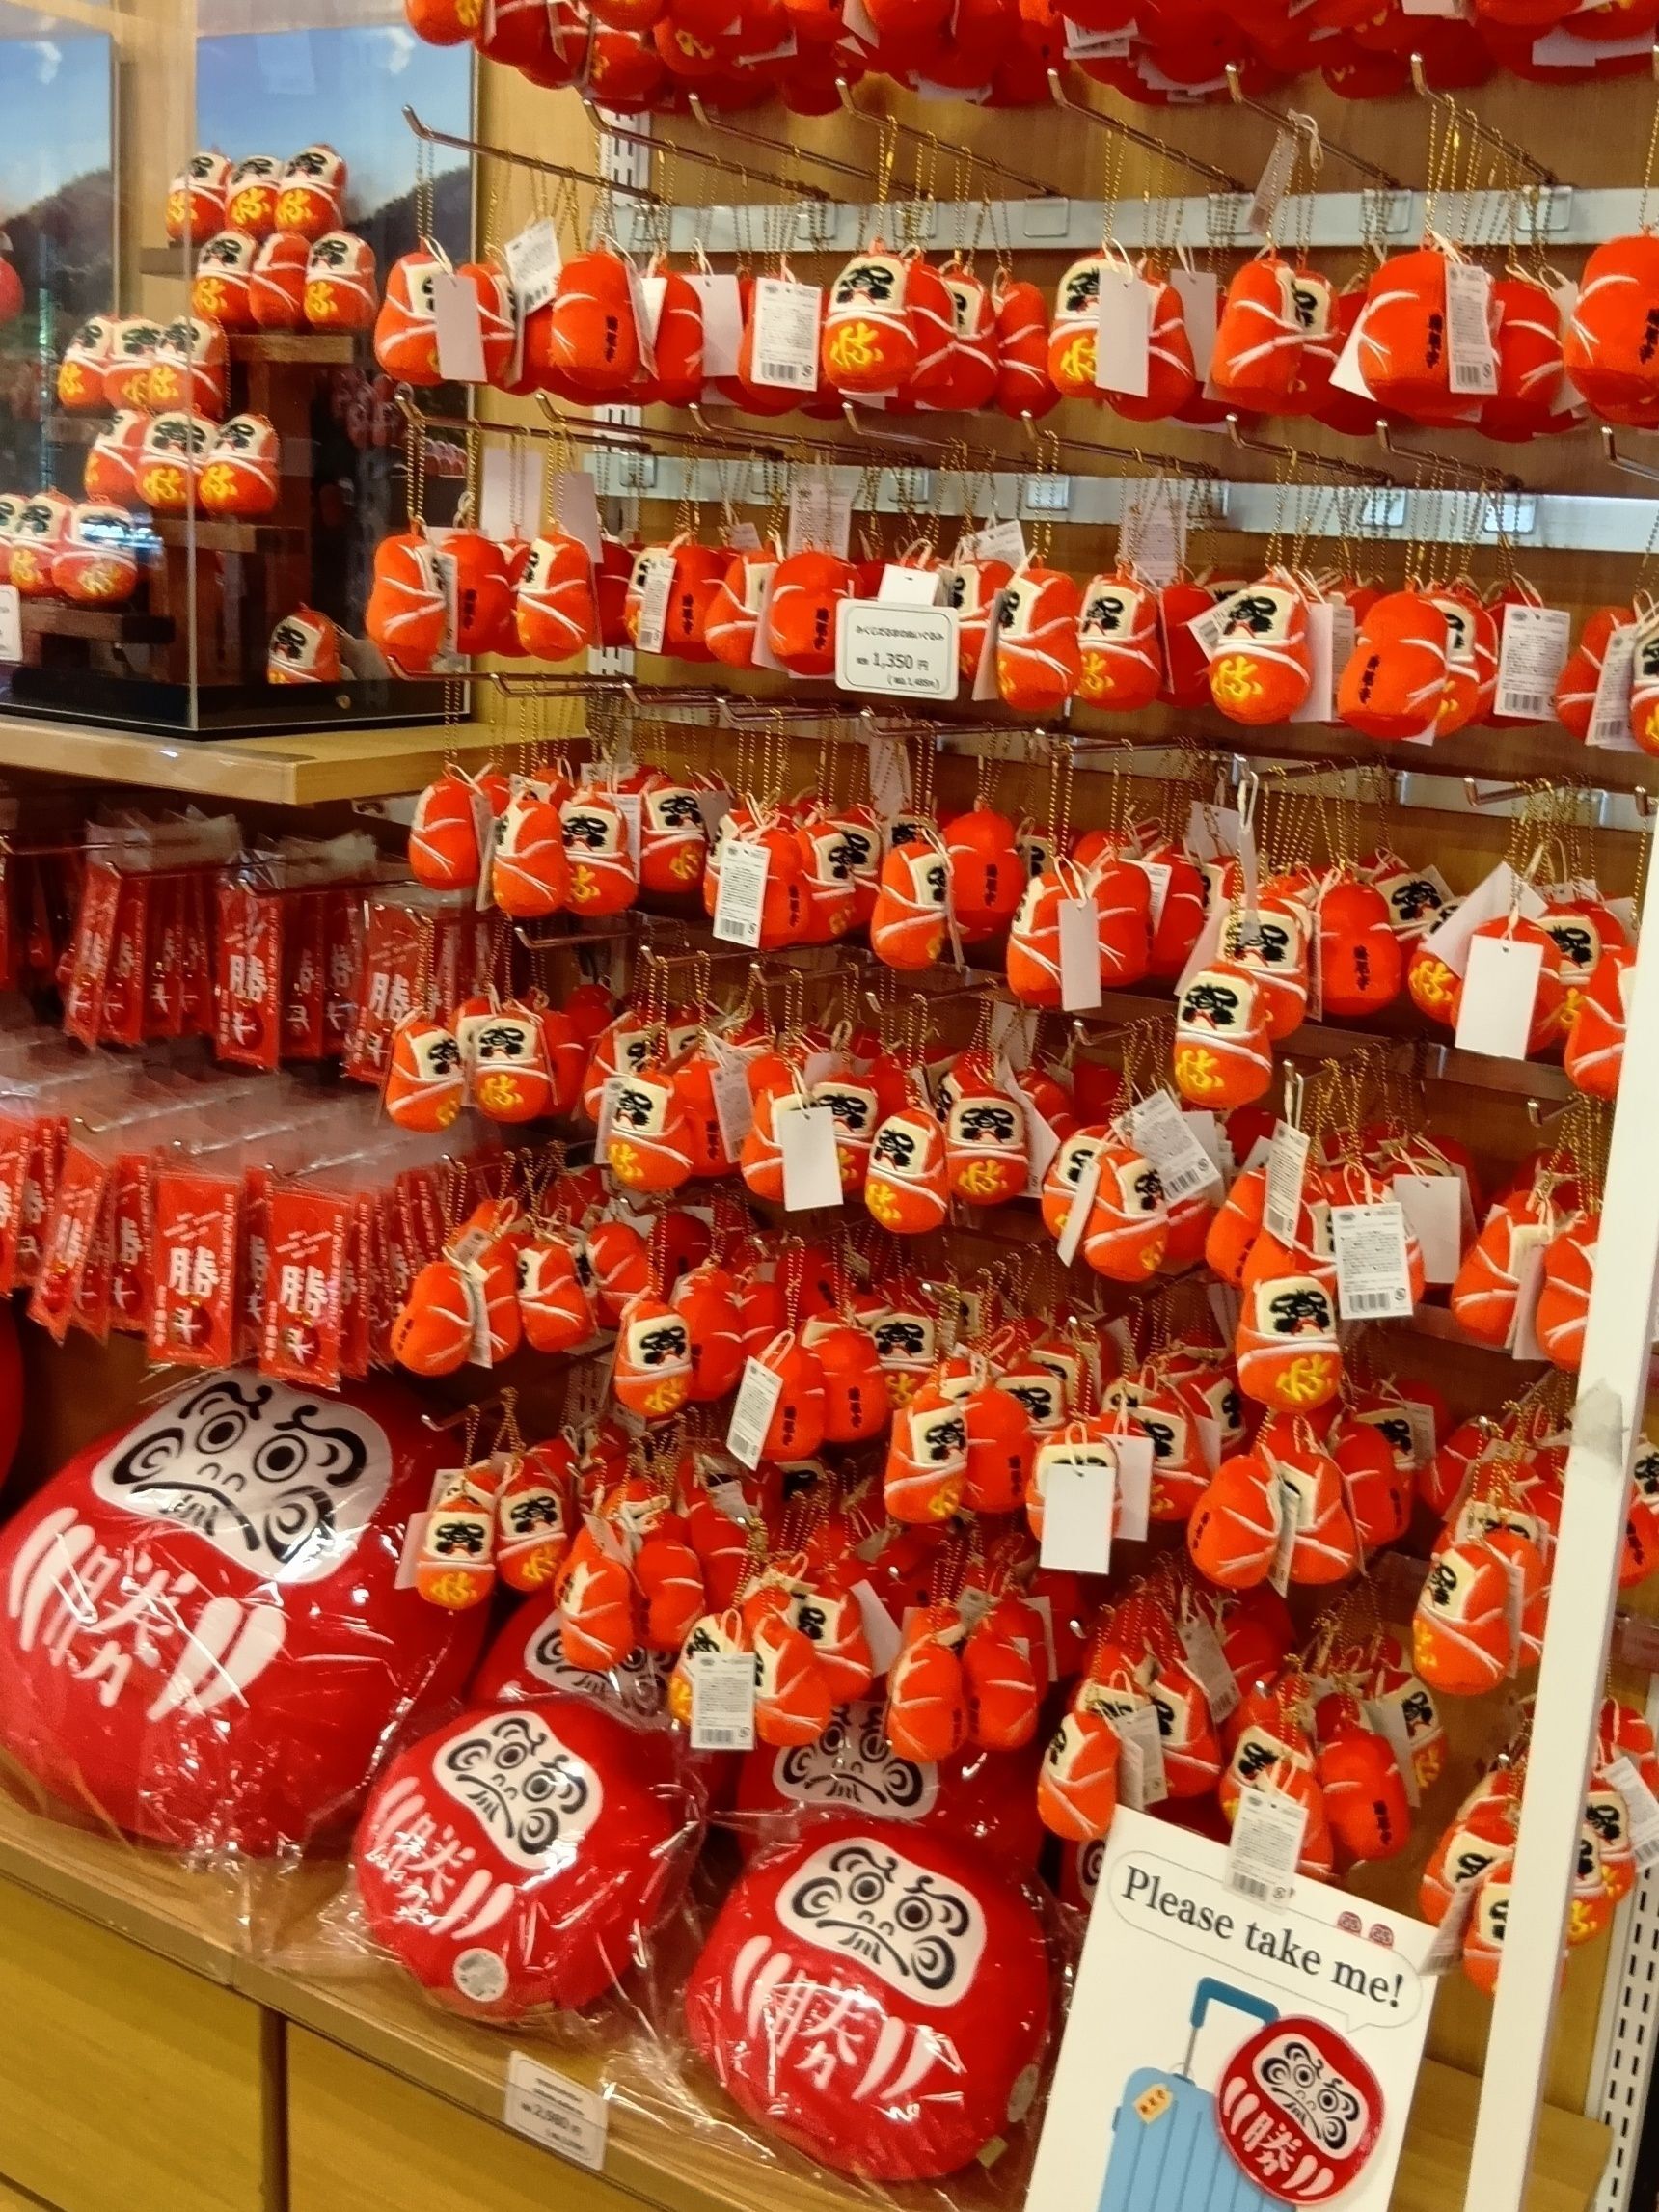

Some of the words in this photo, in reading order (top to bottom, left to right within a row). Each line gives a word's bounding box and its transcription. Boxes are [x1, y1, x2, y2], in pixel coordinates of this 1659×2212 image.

[873, 652, 913, 669] 1,350
[230, 955, 267, 1002] 勝
[169, 1246, 221, 1298] 勝
[279, 1265, 329, 1317] 勝
[1121, 1865, 1234, 1939] Please
[1245, 1922, 1321, 1976] take
[1331, 1960, 1404, 2008] me!
[1242, 2111, 1303, 2177] 勝
